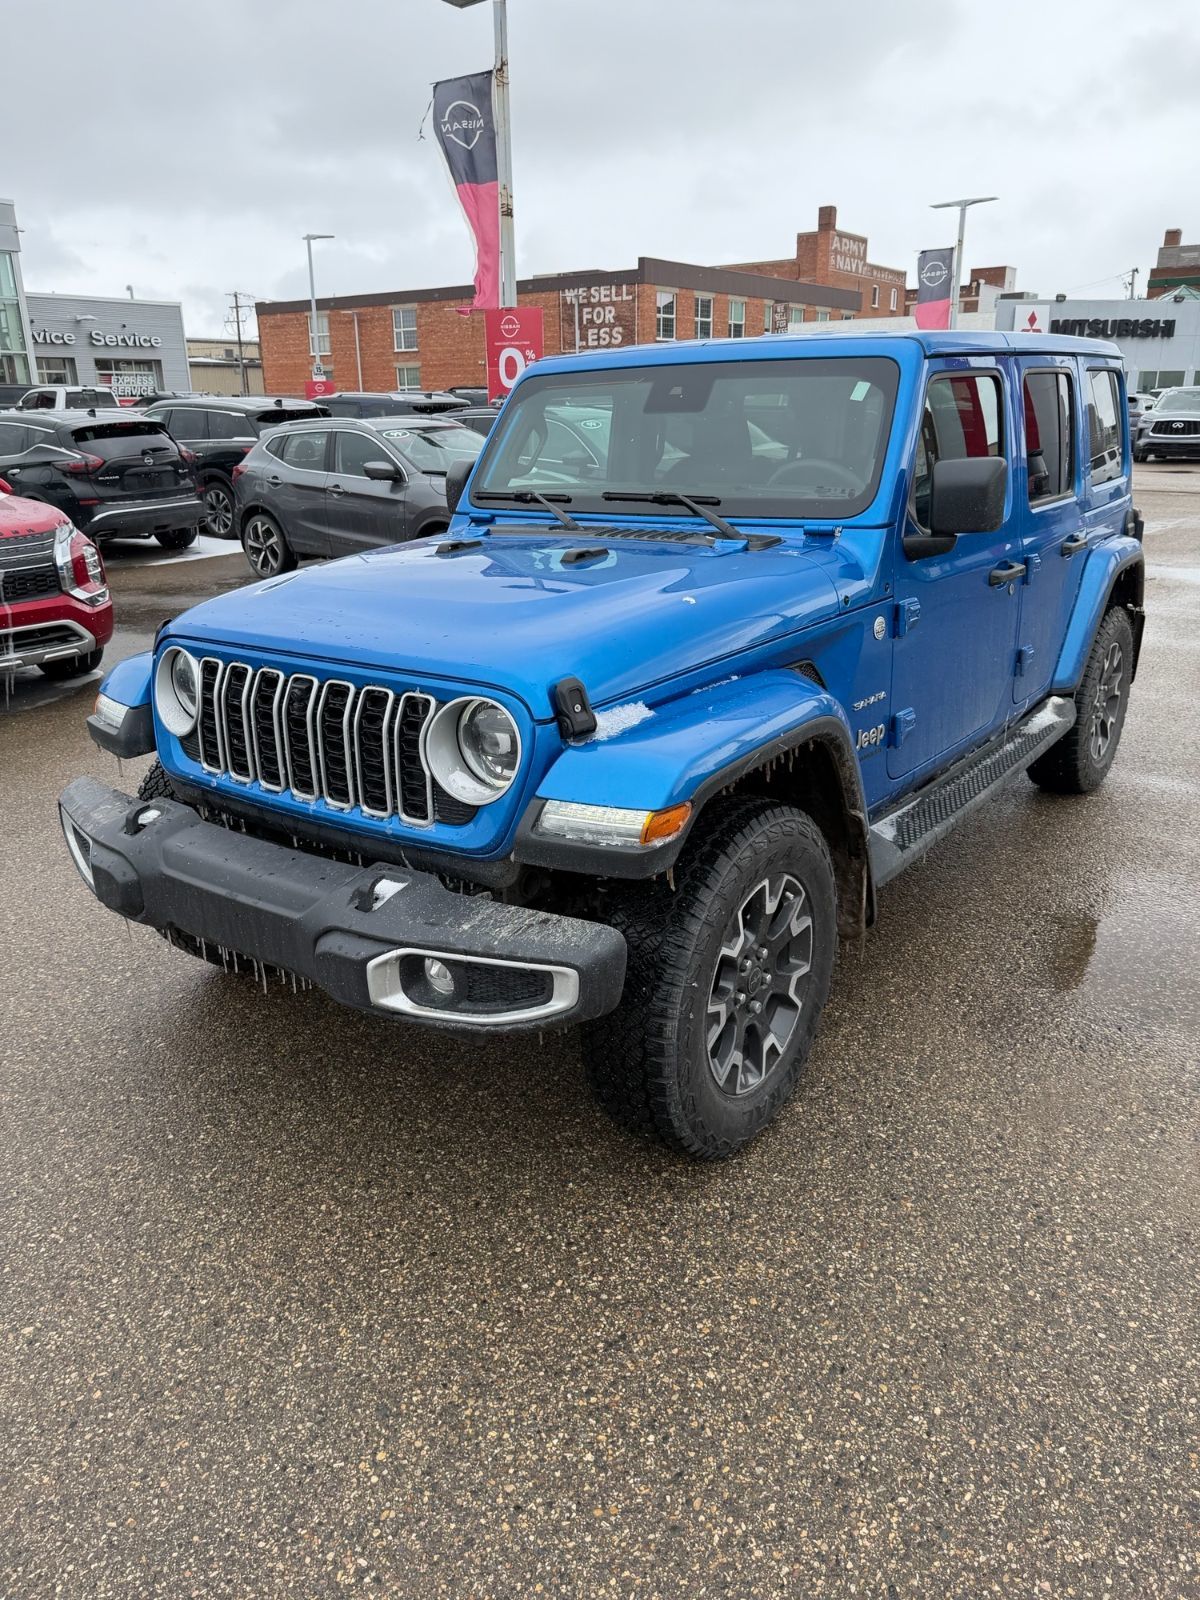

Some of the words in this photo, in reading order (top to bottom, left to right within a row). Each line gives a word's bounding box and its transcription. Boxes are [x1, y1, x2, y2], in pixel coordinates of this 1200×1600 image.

[831, 234, 866, 257] ARMY
[836, 254, 864, 275] NAVY
[565, 287, 588, 305] WE
[590, 284, 633, 303] SELL
[582, 306, 616, 325] FOR
[32, 328, 77, 344] vice
[90, 330, 162, 347] Service
[1050, 319, 1176, 337] MITSUBISHI
[111, 375, 155, 386] EXPRESS
[111, 386, 156, 397] SERVICE
[853, 691, 887, 711] SAHARA
[856, 723, 886, 751] Jeep
